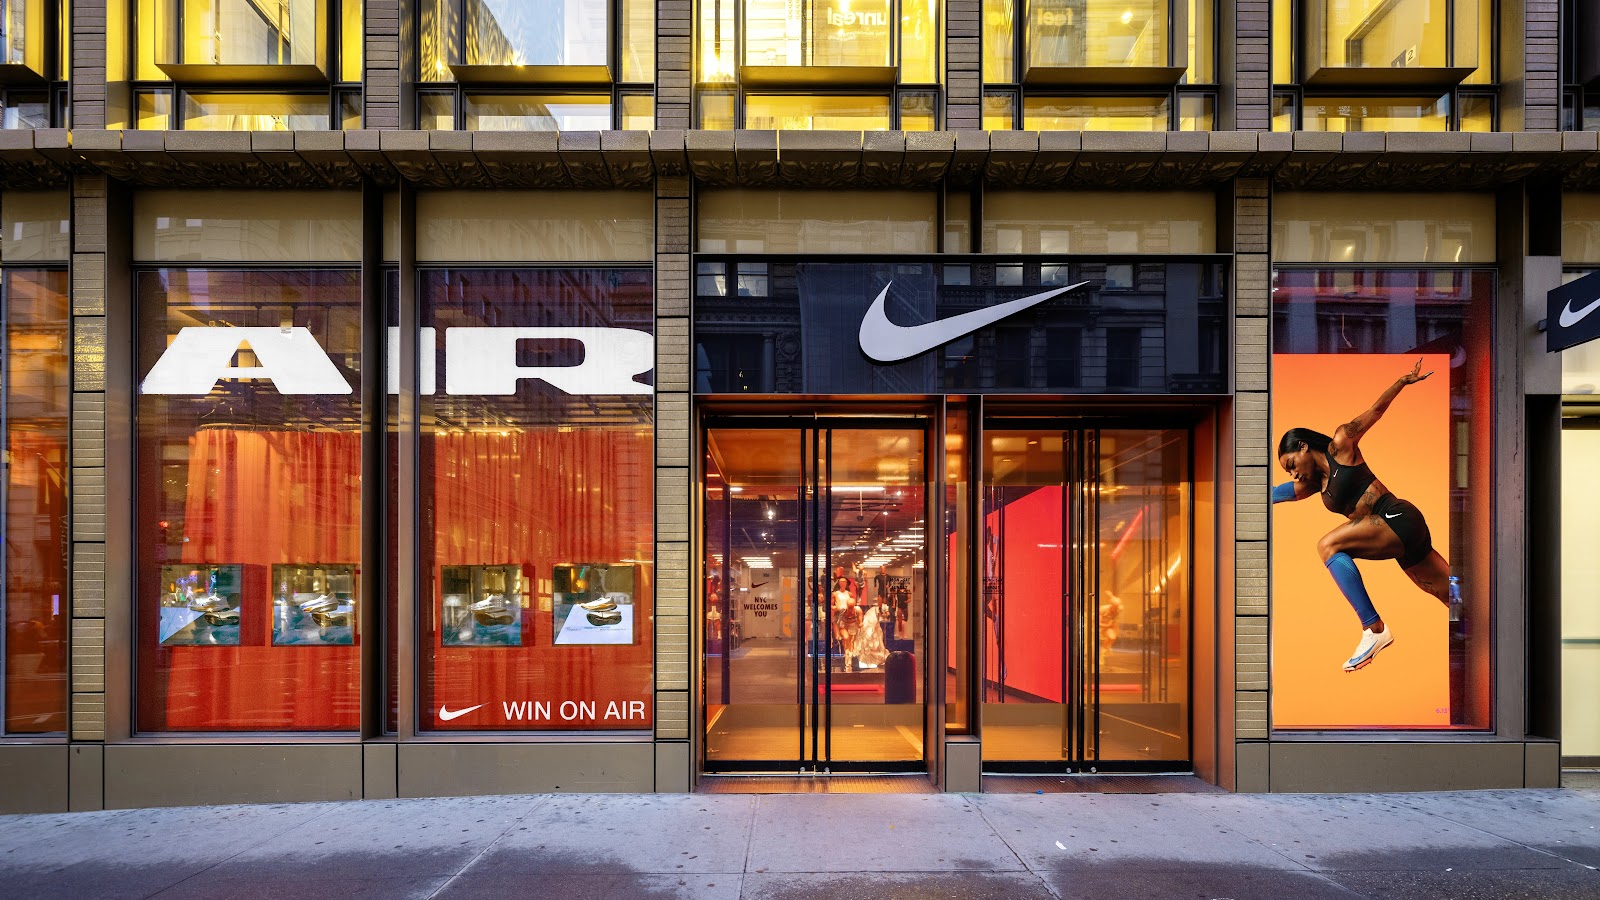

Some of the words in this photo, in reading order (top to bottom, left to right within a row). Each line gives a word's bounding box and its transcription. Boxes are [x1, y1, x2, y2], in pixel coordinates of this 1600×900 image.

[139, 326, 653, 395] AIR
[503, 701, 550, 720] WIN
[560, 701, 596, 720] ON
[604, 701, 645, 720] AIR
